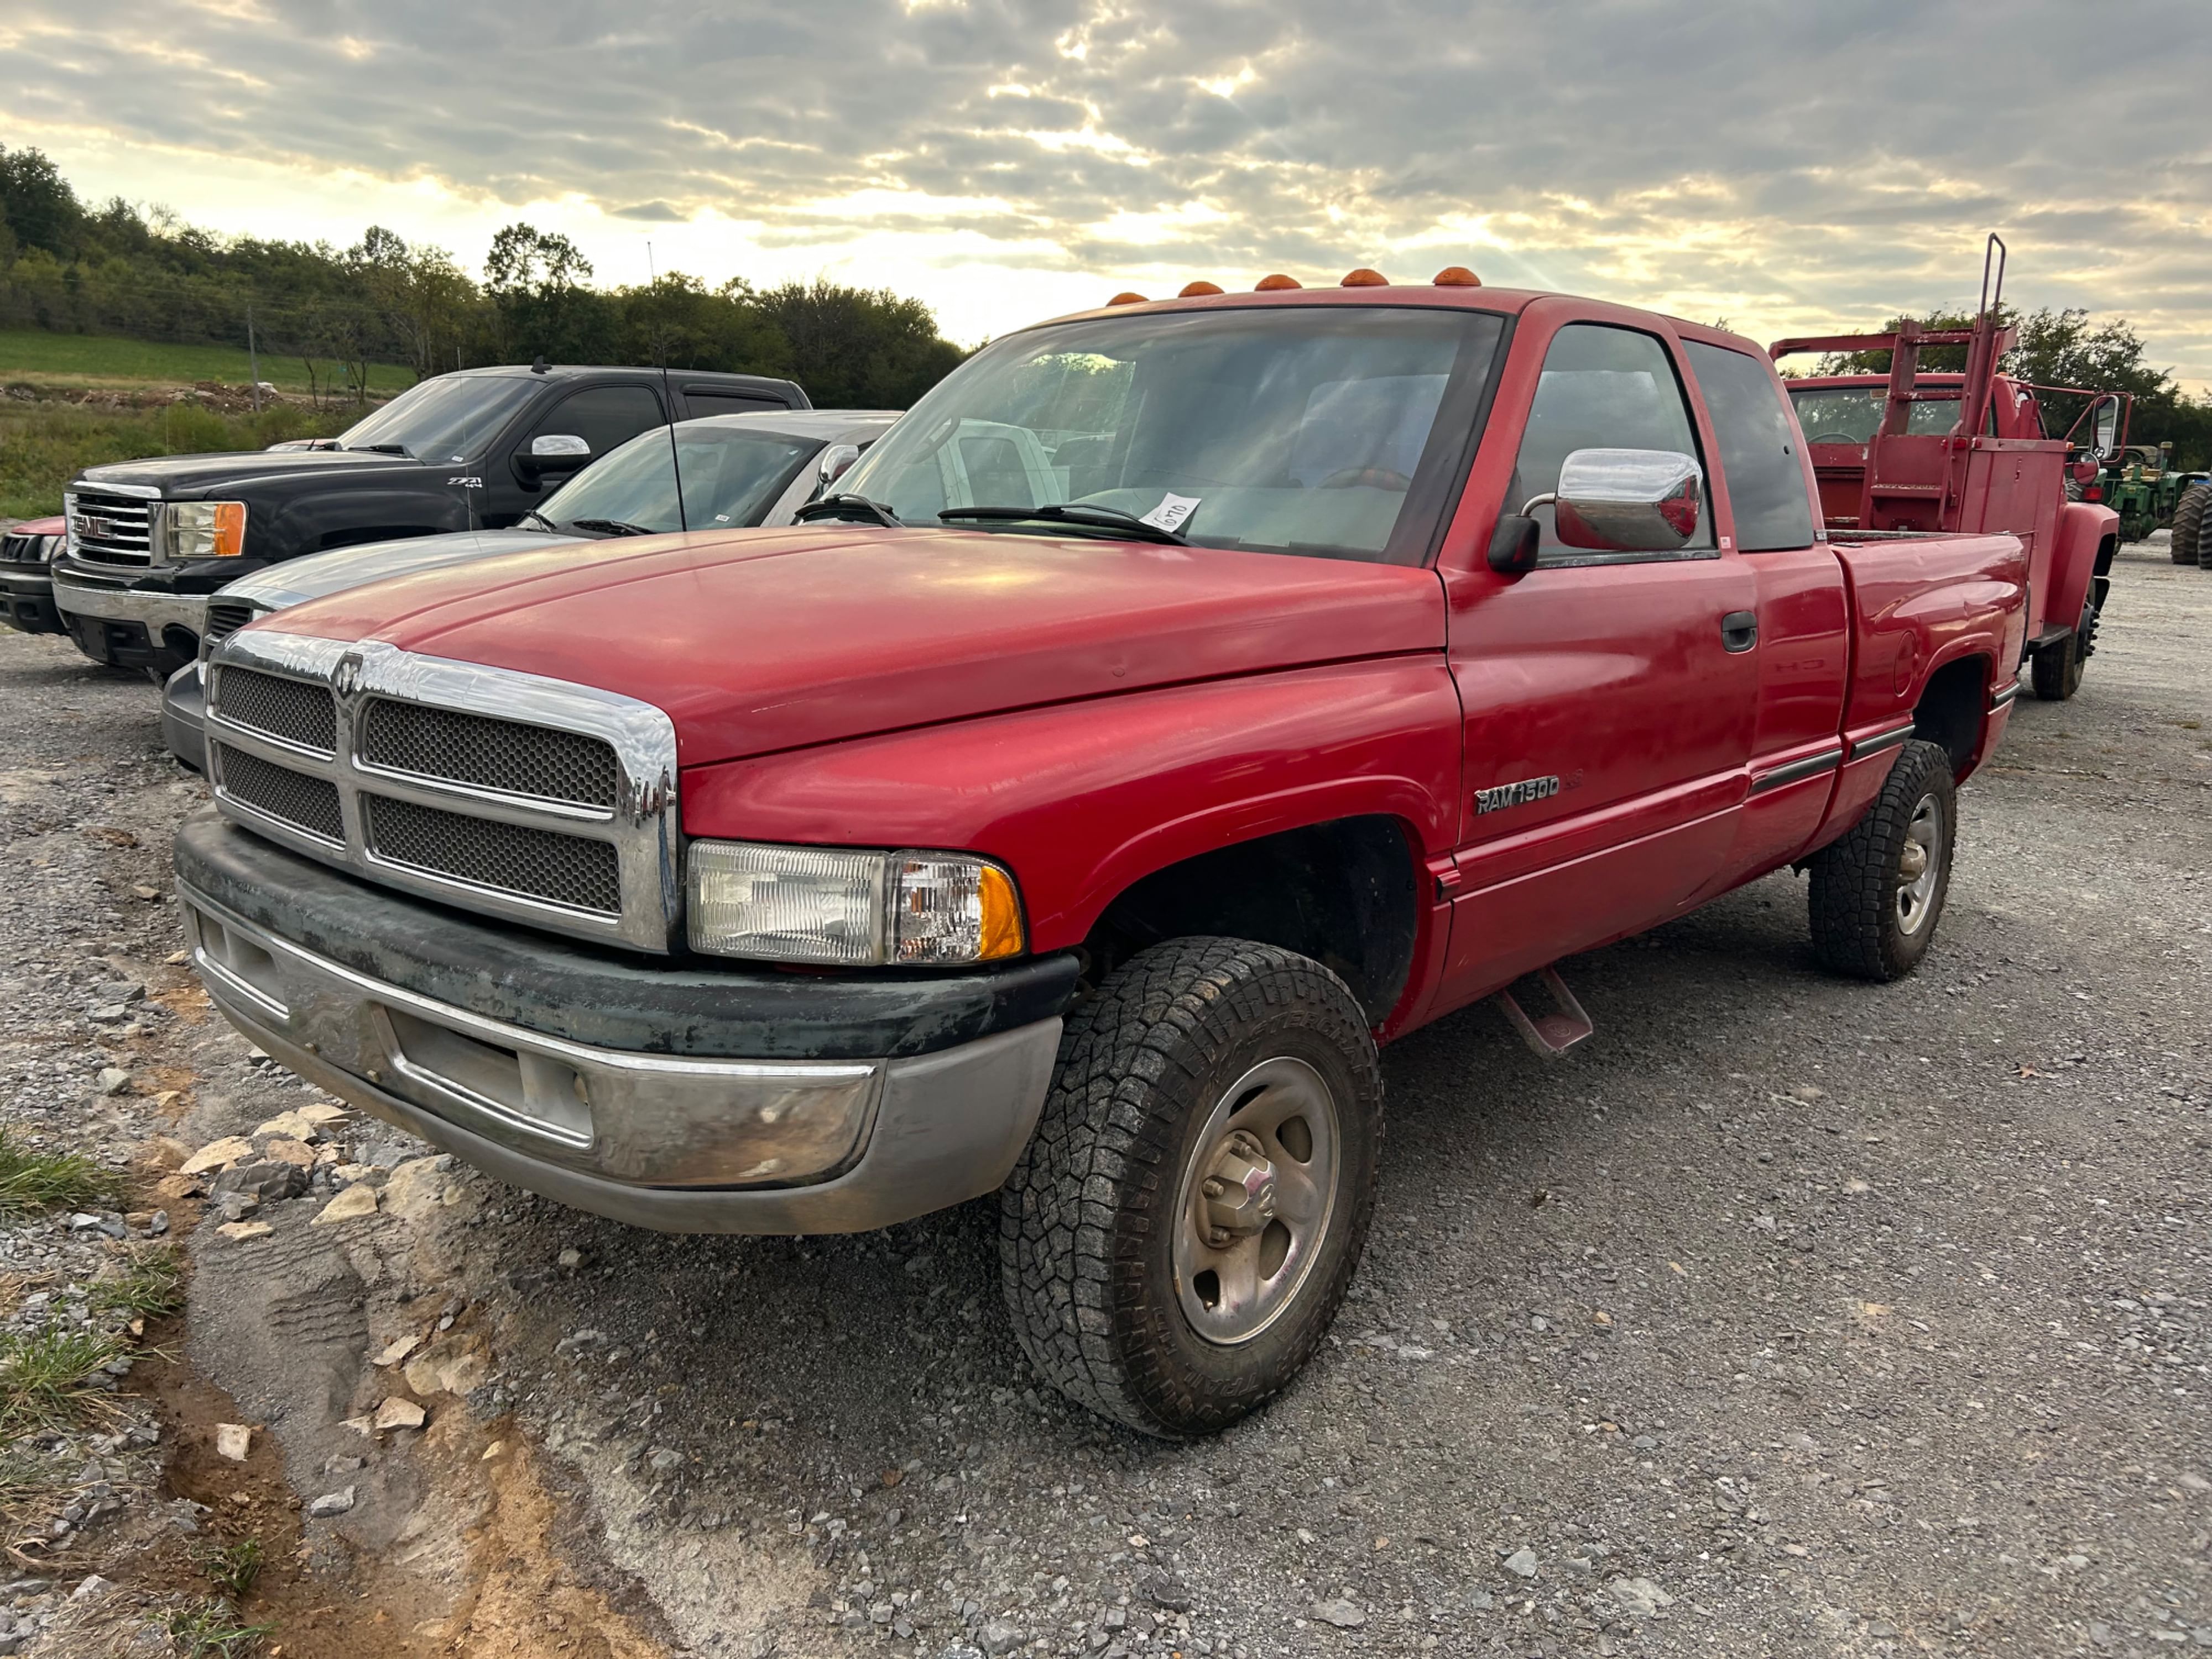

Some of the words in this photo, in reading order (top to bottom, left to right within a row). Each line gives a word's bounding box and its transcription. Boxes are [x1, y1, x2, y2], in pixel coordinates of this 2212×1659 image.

[73, 515, 111, 538] GMC
[1475, 784, 1517, 815] RAM
[1519, 775, 1559, 803] 1500
